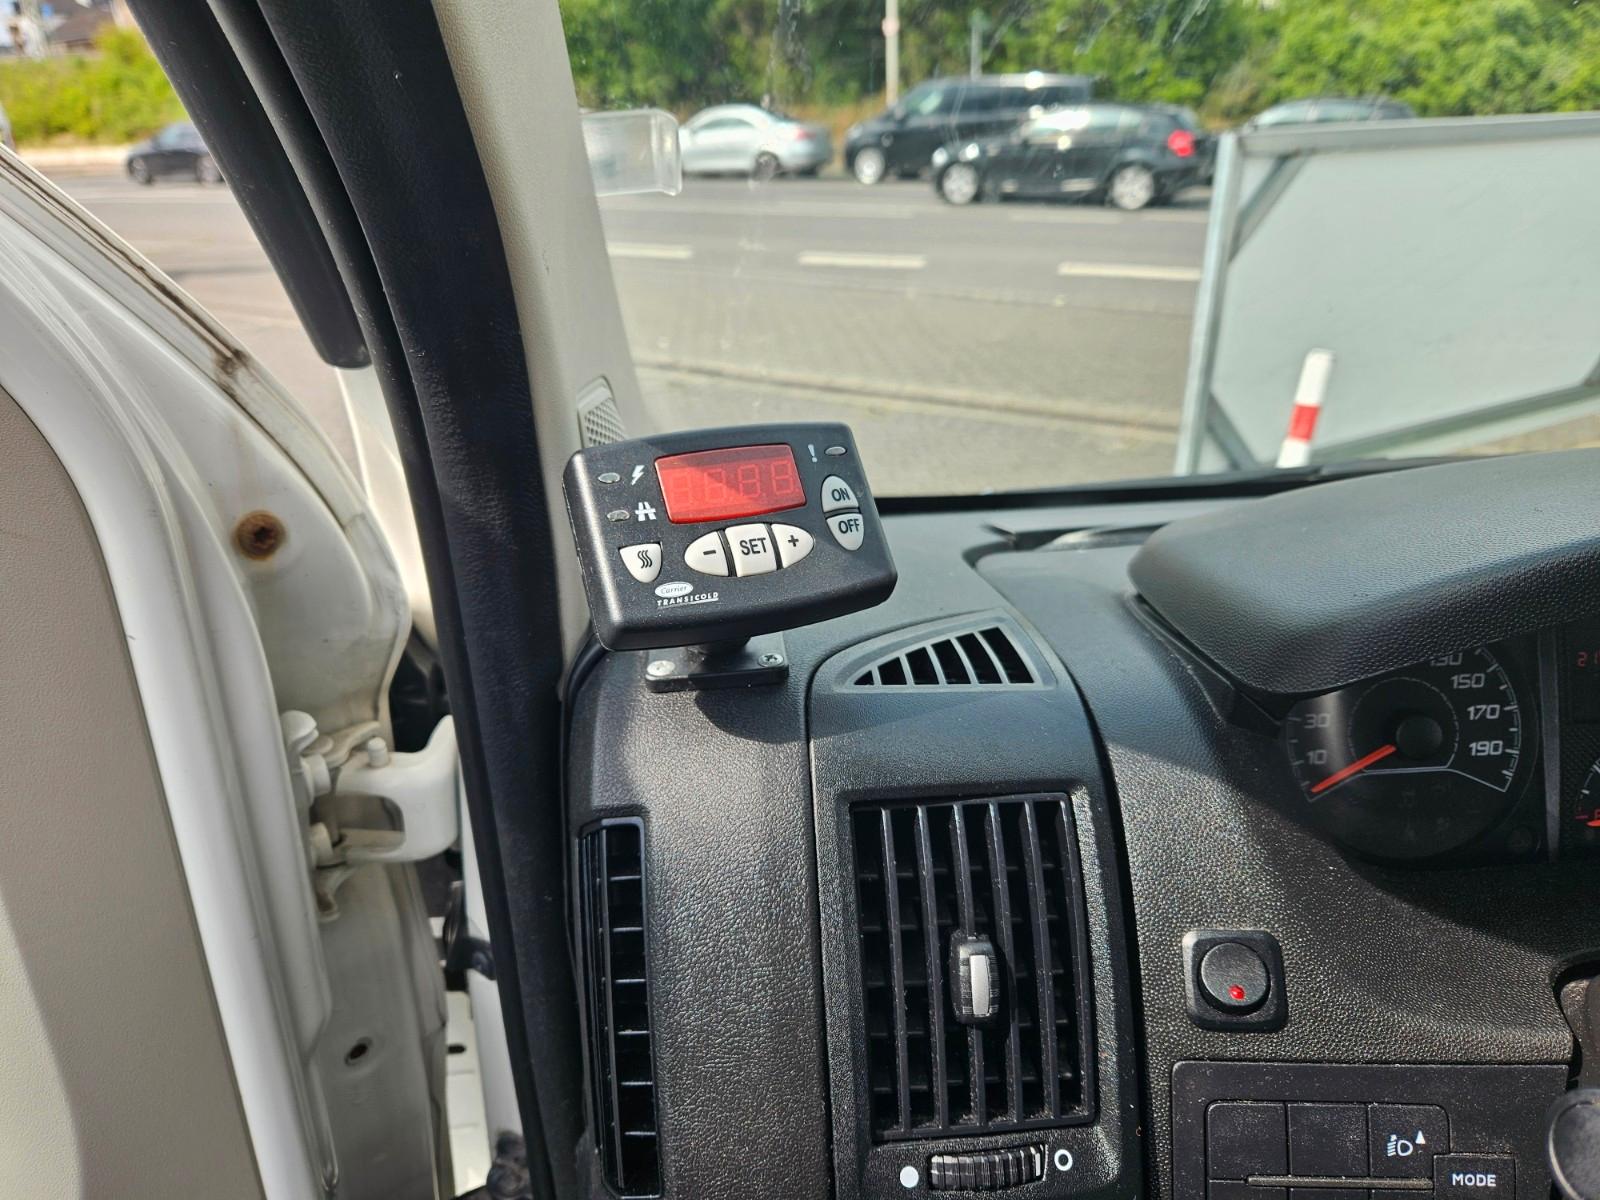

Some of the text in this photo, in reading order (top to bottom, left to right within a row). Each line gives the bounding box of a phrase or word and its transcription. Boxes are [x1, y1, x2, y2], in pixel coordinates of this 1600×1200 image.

[831, 487, 850, 502] ON
[838, 519, 861, 534] OFF
[739, 537, 767, 556] SET
[659, 584, 688, 595] Carrier
[656, 591, 719, 607] TRANSICOLD
[1450, 672, 1486, 689] 150
[1466, 704, 1500, 720] 170
[1303, 713, 1331, 729] 30
[1468, 740, 1504, 756] 190
[1306, 750, 1327, 765] 10
[1452, 1172, 1497, 1187] MODE
